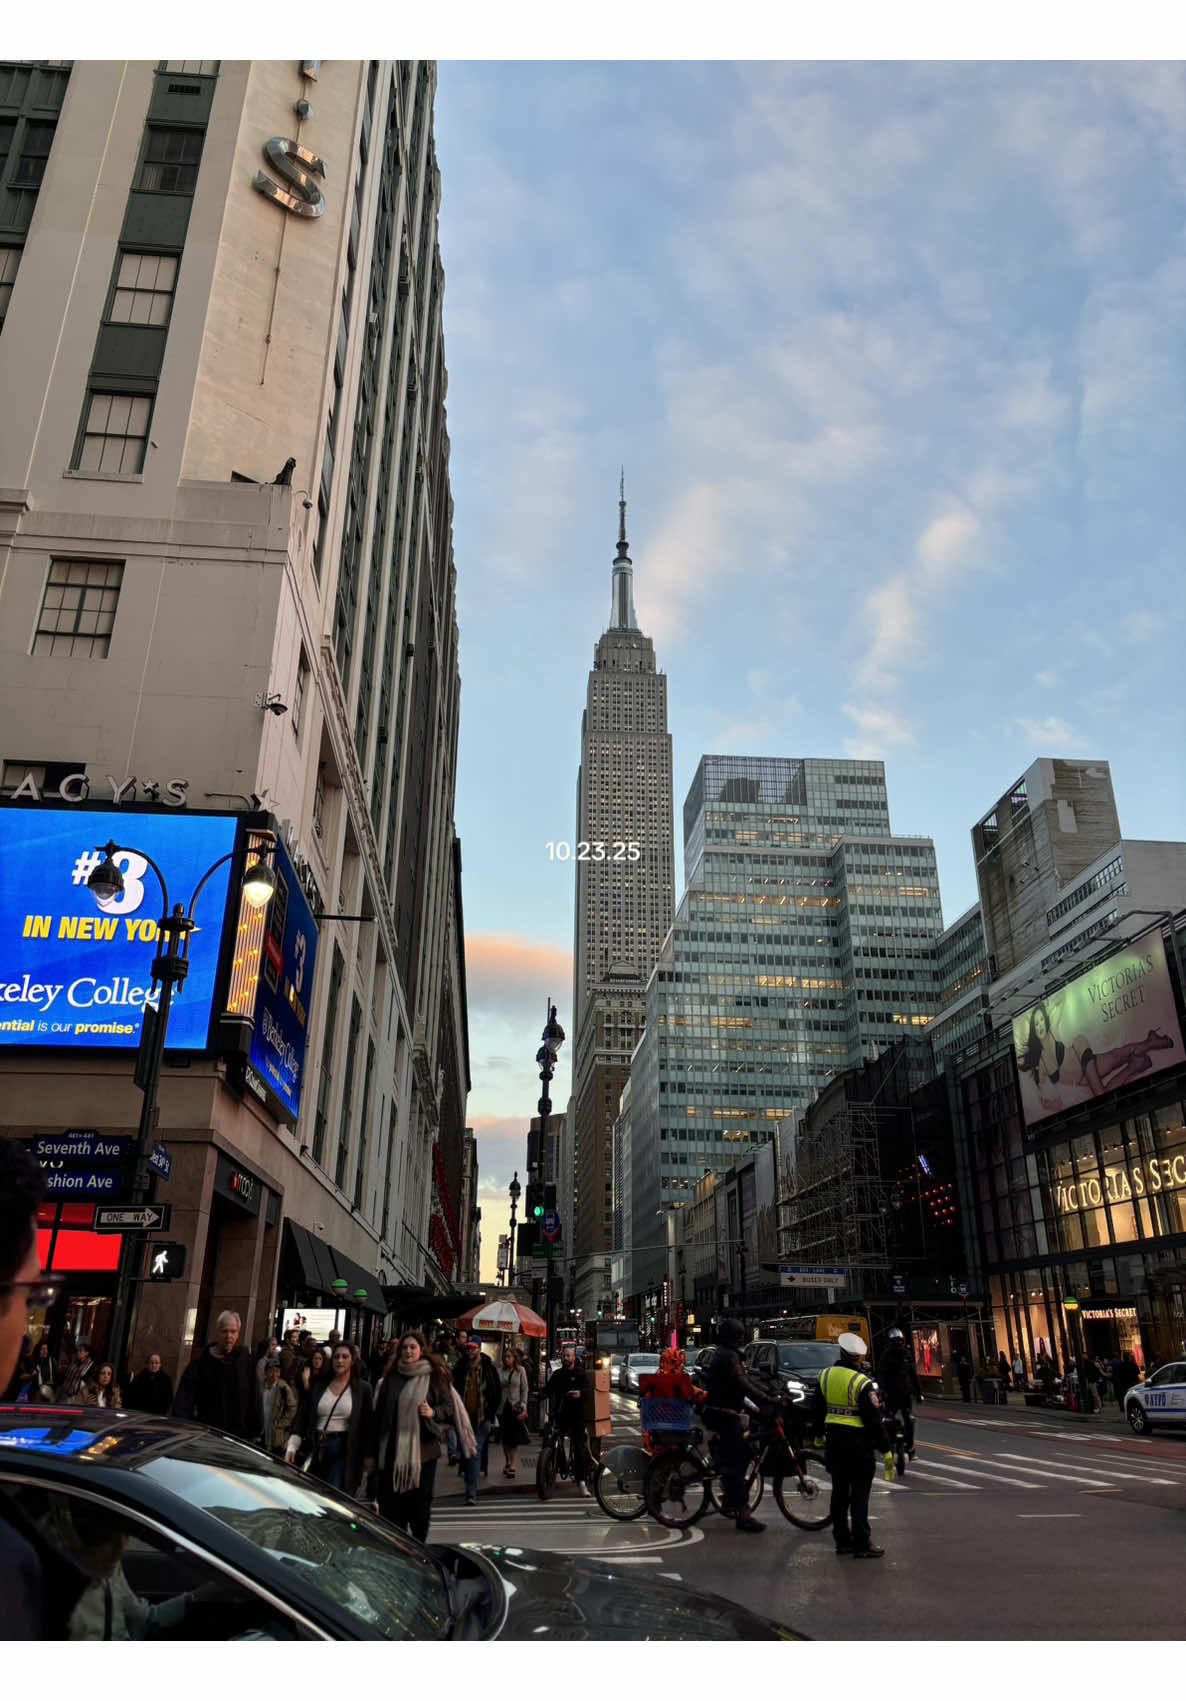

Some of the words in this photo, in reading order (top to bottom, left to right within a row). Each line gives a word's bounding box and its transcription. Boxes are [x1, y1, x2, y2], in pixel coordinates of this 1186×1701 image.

[22, 915, 52, 939] IN
[58, 916, 119, 941] NEW
[1101, 984, 1145, 1022] SECRET
[37, 1022, 49, 1033] is
[51, 1023, 72, 1033] our
[36, 1140, 91, 1156] Seventh
[94, 1142, 121, 1156] Ave
[47, 1173, 84, 1189] shion
[86, 1174, 113, 1189] Ave
[106, 1212, 123, 1222] ONE
[133, 1213, 154, 1222] WAY
